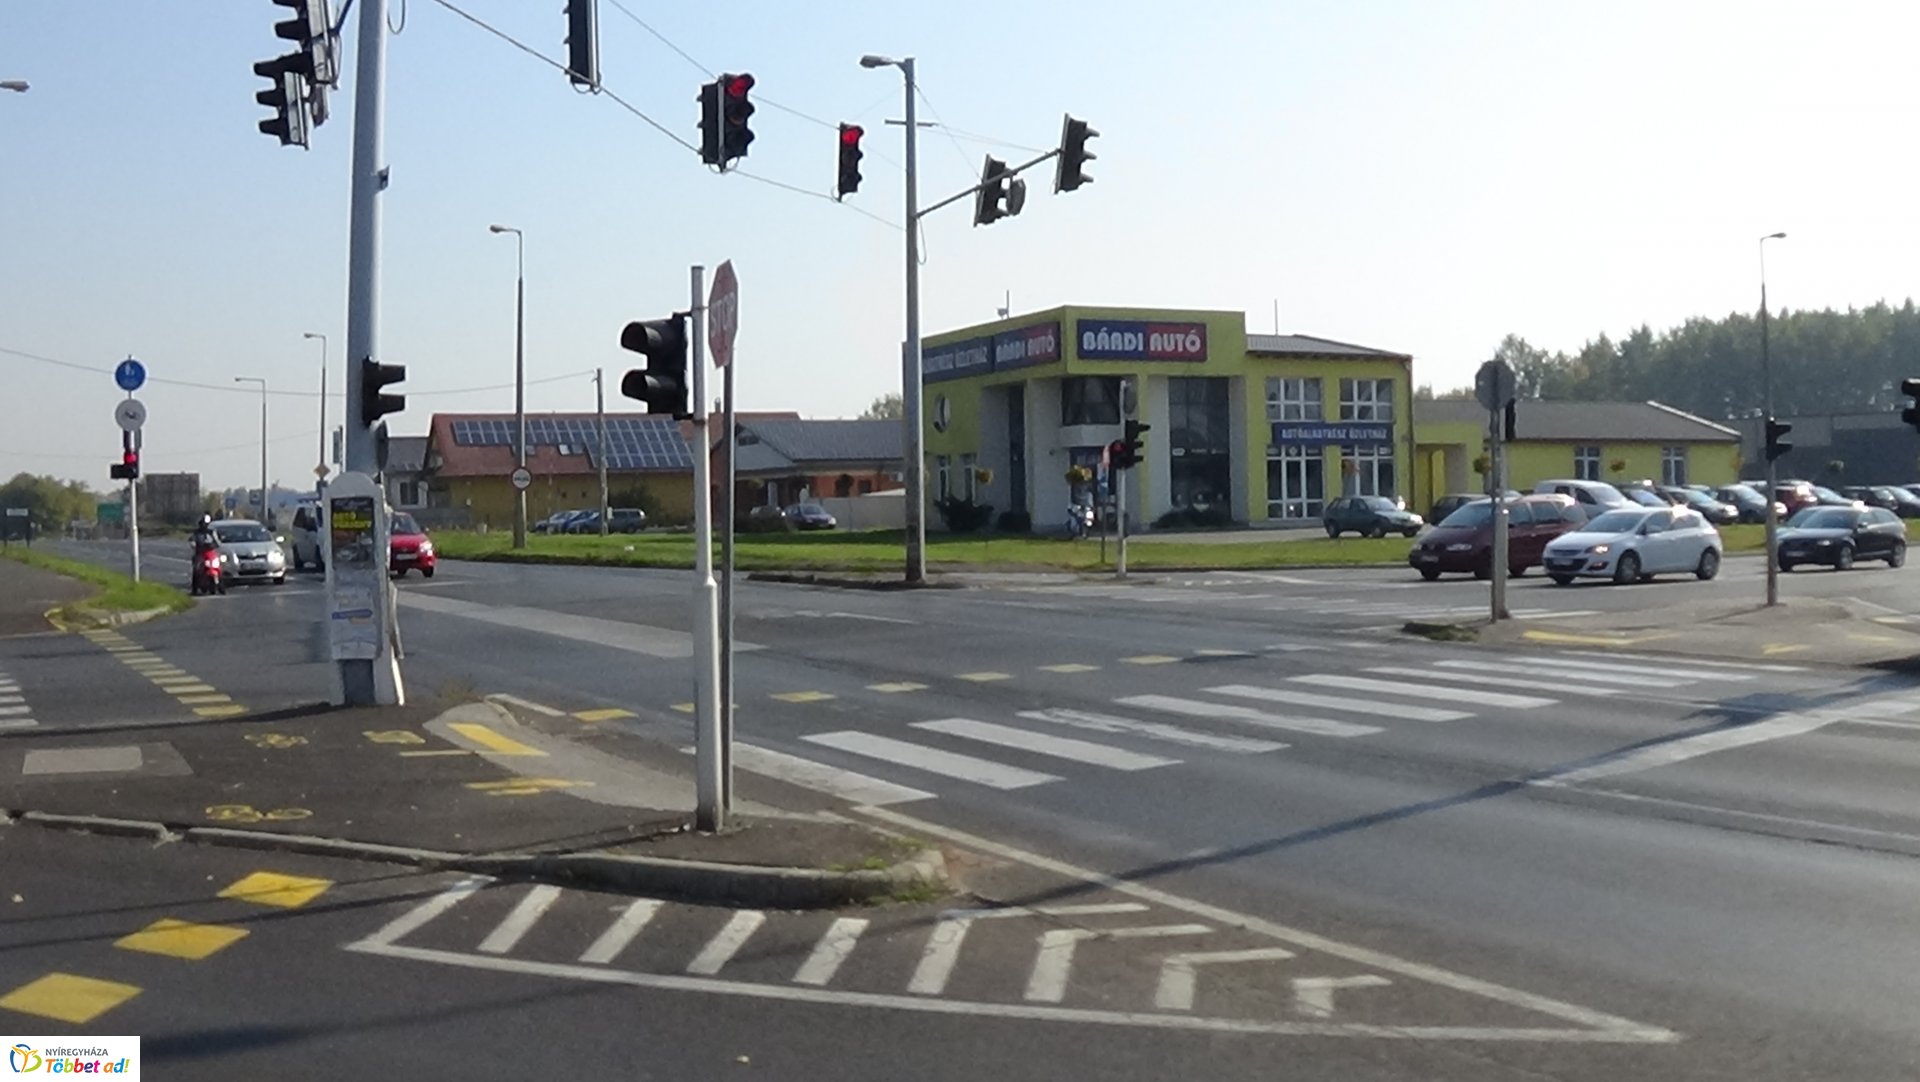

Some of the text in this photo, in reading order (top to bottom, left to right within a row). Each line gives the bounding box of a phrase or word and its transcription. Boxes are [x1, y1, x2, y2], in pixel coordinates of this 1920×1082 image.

[710, 291, 736, 339] STOP
[1027, 328, 1055, 356] AUTÓ
[1082, 326, 1201, 352] BÁRDI AUTÓ
